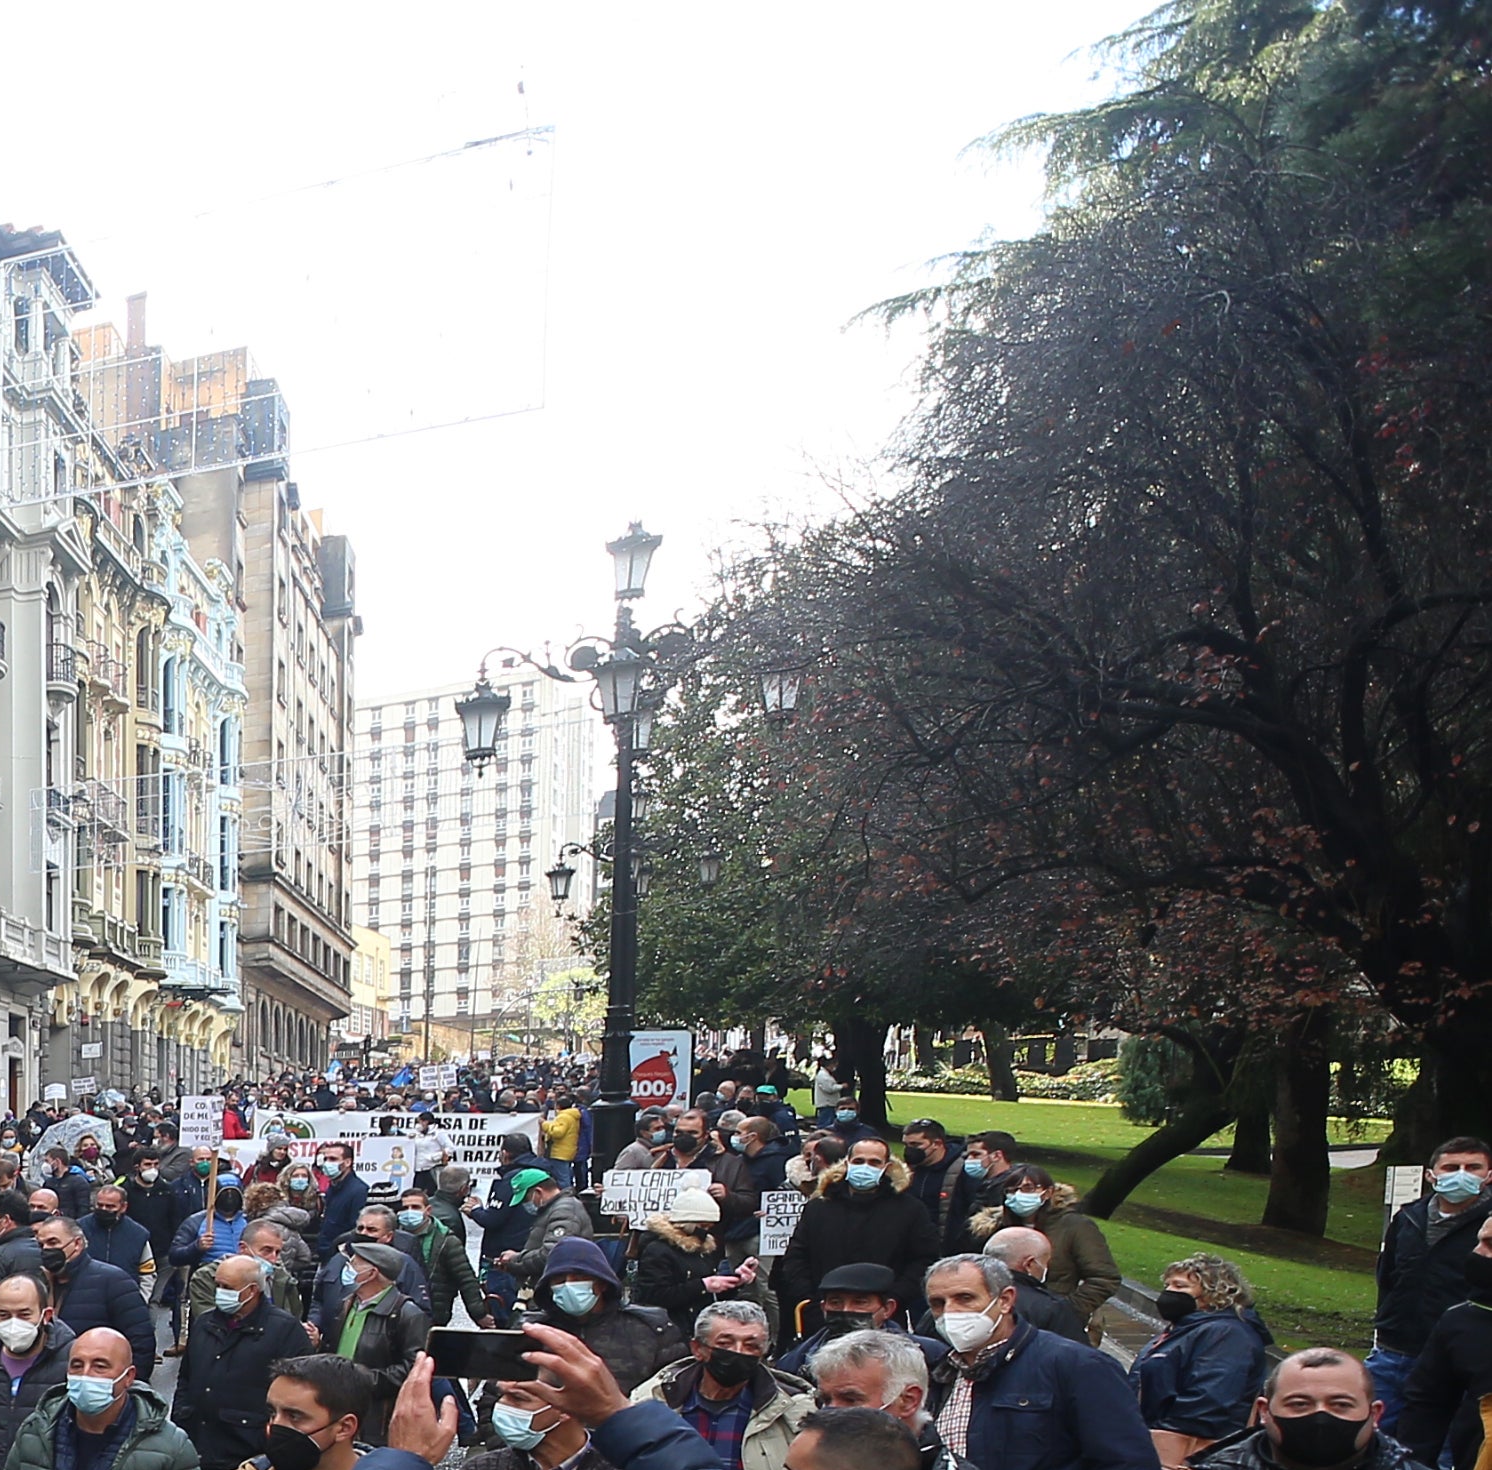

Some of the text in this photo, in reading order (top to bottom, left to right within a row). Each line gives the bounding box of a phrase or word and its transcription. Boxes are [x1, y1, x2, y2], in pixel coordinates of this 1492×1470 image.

[468, 1117, 488, 1131] DE
[610, 1171, 634, 1187] EL
[629, 1188, 677, 1202] LUCHA
